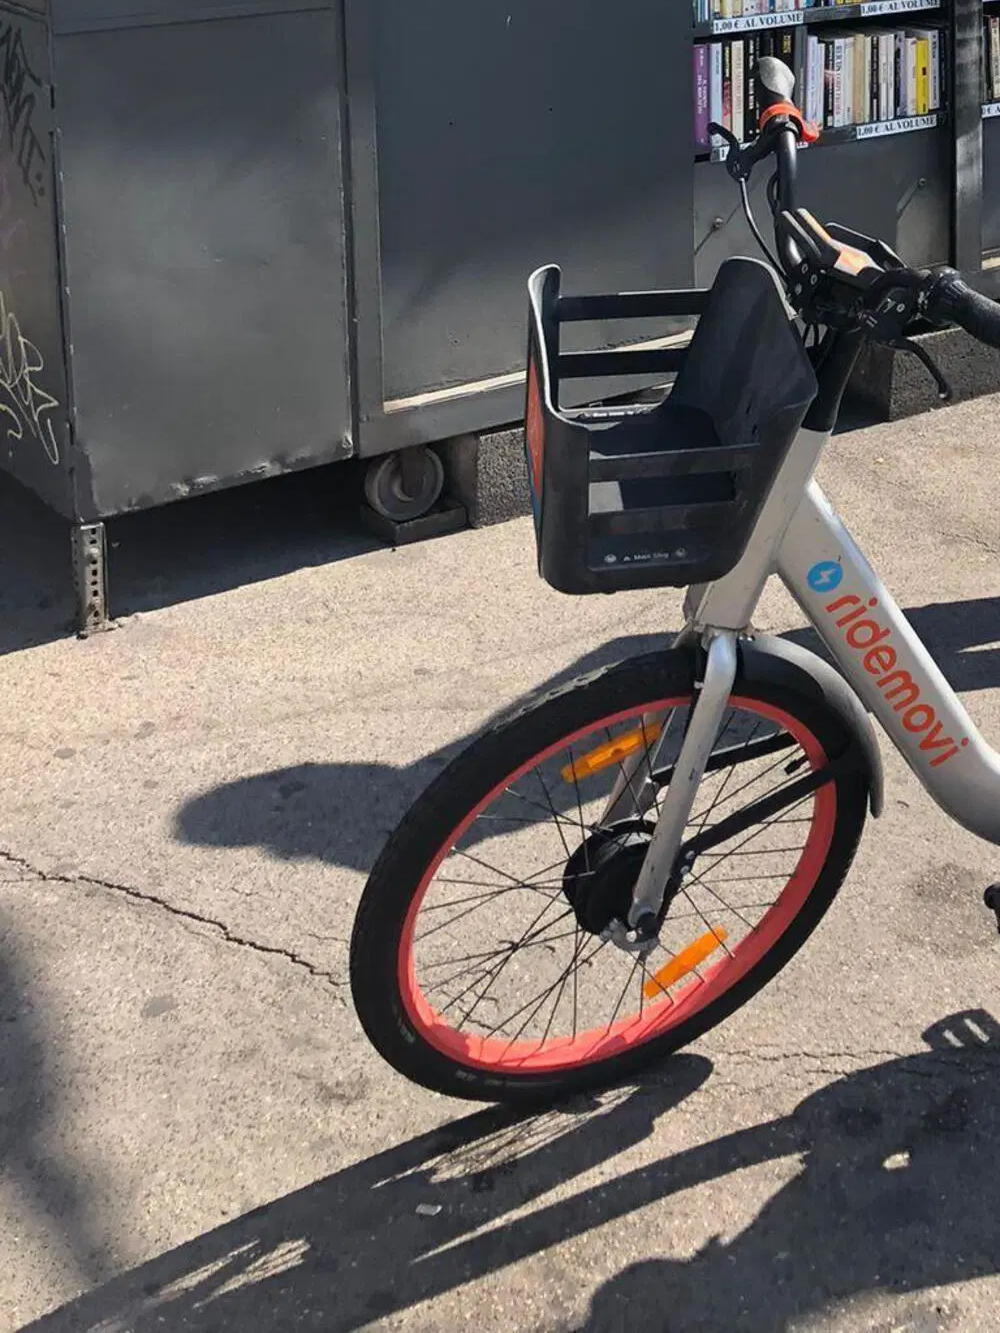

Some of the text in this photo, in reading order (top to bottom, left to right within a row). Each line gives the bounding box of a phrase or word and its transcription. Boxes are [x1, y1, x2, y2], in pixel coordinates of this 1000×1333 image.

[862, 4, 877, 15] 1,00
[878, 3, 885, 12] €
[888, 1, 899, 11] AL
[715, 13, 803, 32] 1,00 € AL VOLUME
[858, 116, 936, 136] 1,00 € AL VOLUME
[825, 594, 970, 768] ridemovi
